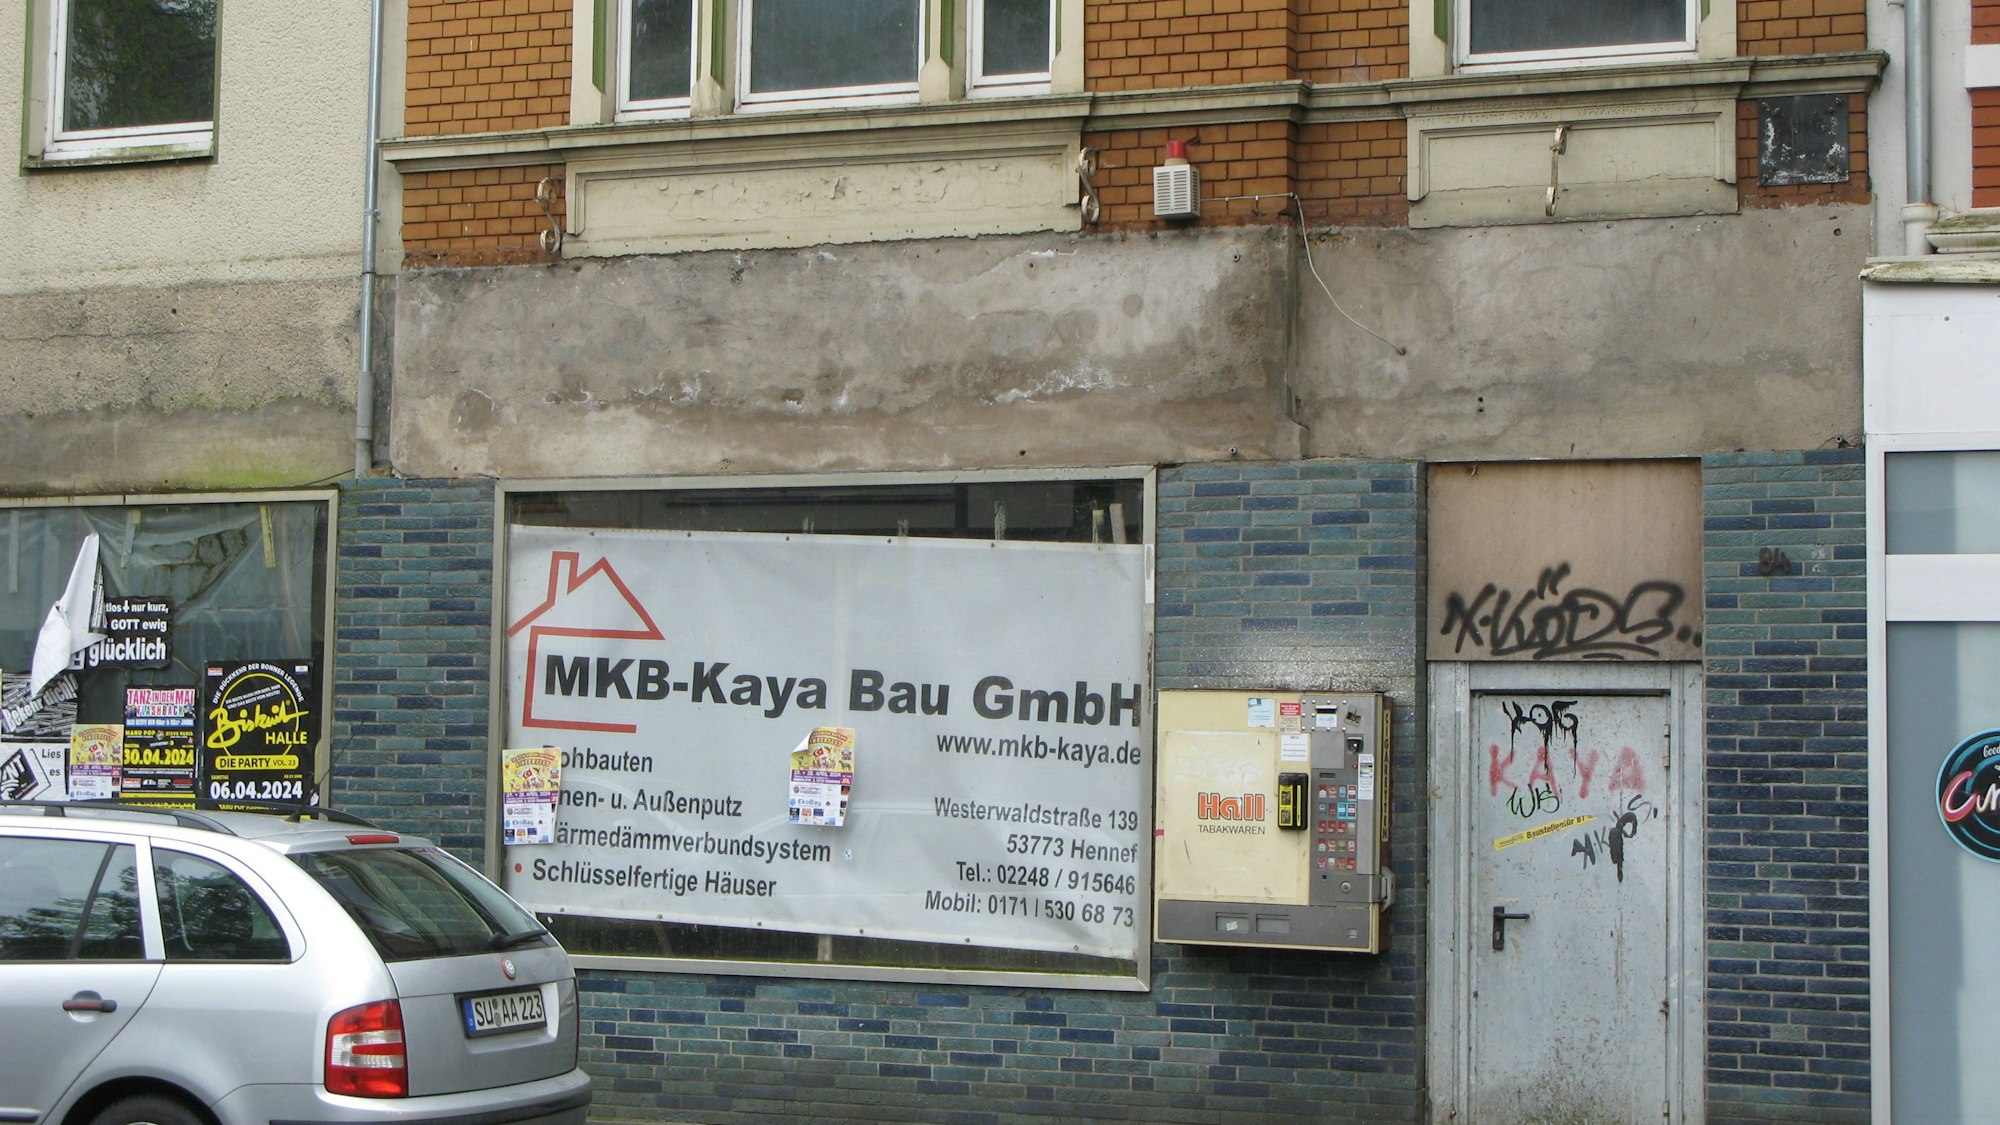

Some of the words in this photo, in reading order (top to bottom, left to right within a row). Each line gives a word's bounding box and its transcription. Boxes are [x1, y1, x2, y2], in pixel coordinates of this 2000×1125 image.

[131, 603, 146, 612] nur
[148, 602, 168, 613] kurz,
[111, 619, 140, 630] GOTT
[142, 619, 167, 632] ewig
[89, 637, 166, 666] glücklich
[219, 666, 247, 692] RÜCKKEHR
[260, 663, 285, 676] BONNER
[284, 673, 305, 702] LEGENDE
[545, 655, 827, 718] MKB-Kaya
[849, 669, 950, 716] Bau
[973, 675, 1142, 727] GmbH
[127, 689, 152, 706] TANZ
[152, 690, 160, 703] IN
[175, 689, 194, 705] MAI
[266, 732, 307, 744] HALLE
[937, 735, 1141, 768] www.mkb-kaya.de
[42, 749, 61, 758] Lies
[124, 749, 194, 765] 30.04.2024
[220, 759, 236, 767] DIE
[239, 758, 270, 767] PARTY
[543, 745, 653, 773] ohbauten
[1489, 744, 1646, 799] KAYA
[210, 781, 303, 799] 06.04.2024
[560, 790, 604, 808] nen-
[611, 793, 627, 810] u.
[633, 788, 742, 820] Außenputz
[935, 797, 1101, 828] Westerwaldstraße
[1108, 810, 1138, 831] 139
[1198, 792, 1265, 821] Hall
[556, 821, 831, 864] ärmedämmverbundsystem
[1198, 824, 1266, 835] TABAKWAREN
[1007, 834, 1064, 857] 53773
[1071, 839, 1138, 863] Hennef
[533, 858, 698, 896] Schlüsselfertige
[705, 869, 777, 897] Häuser
[956, 861, 991, 882] Tel.:
[997, 864, 1050, 887] 02248
[1054, 869, 1063, 888] /
[1068, 870, 1136, 895] 915646
[925, 890, 981, 913] Mobil:
[988, 894, 1028, 917] 0171
[1045, 900, 1075, 921] 530
[1082, 903, 1105, 923] 68
[1112, 906, 1134, 927] 73
[474, 999, 494, 1026] SU
[502, 997, 519, 1023] AA
[520, 995, 543, 1020] 223
